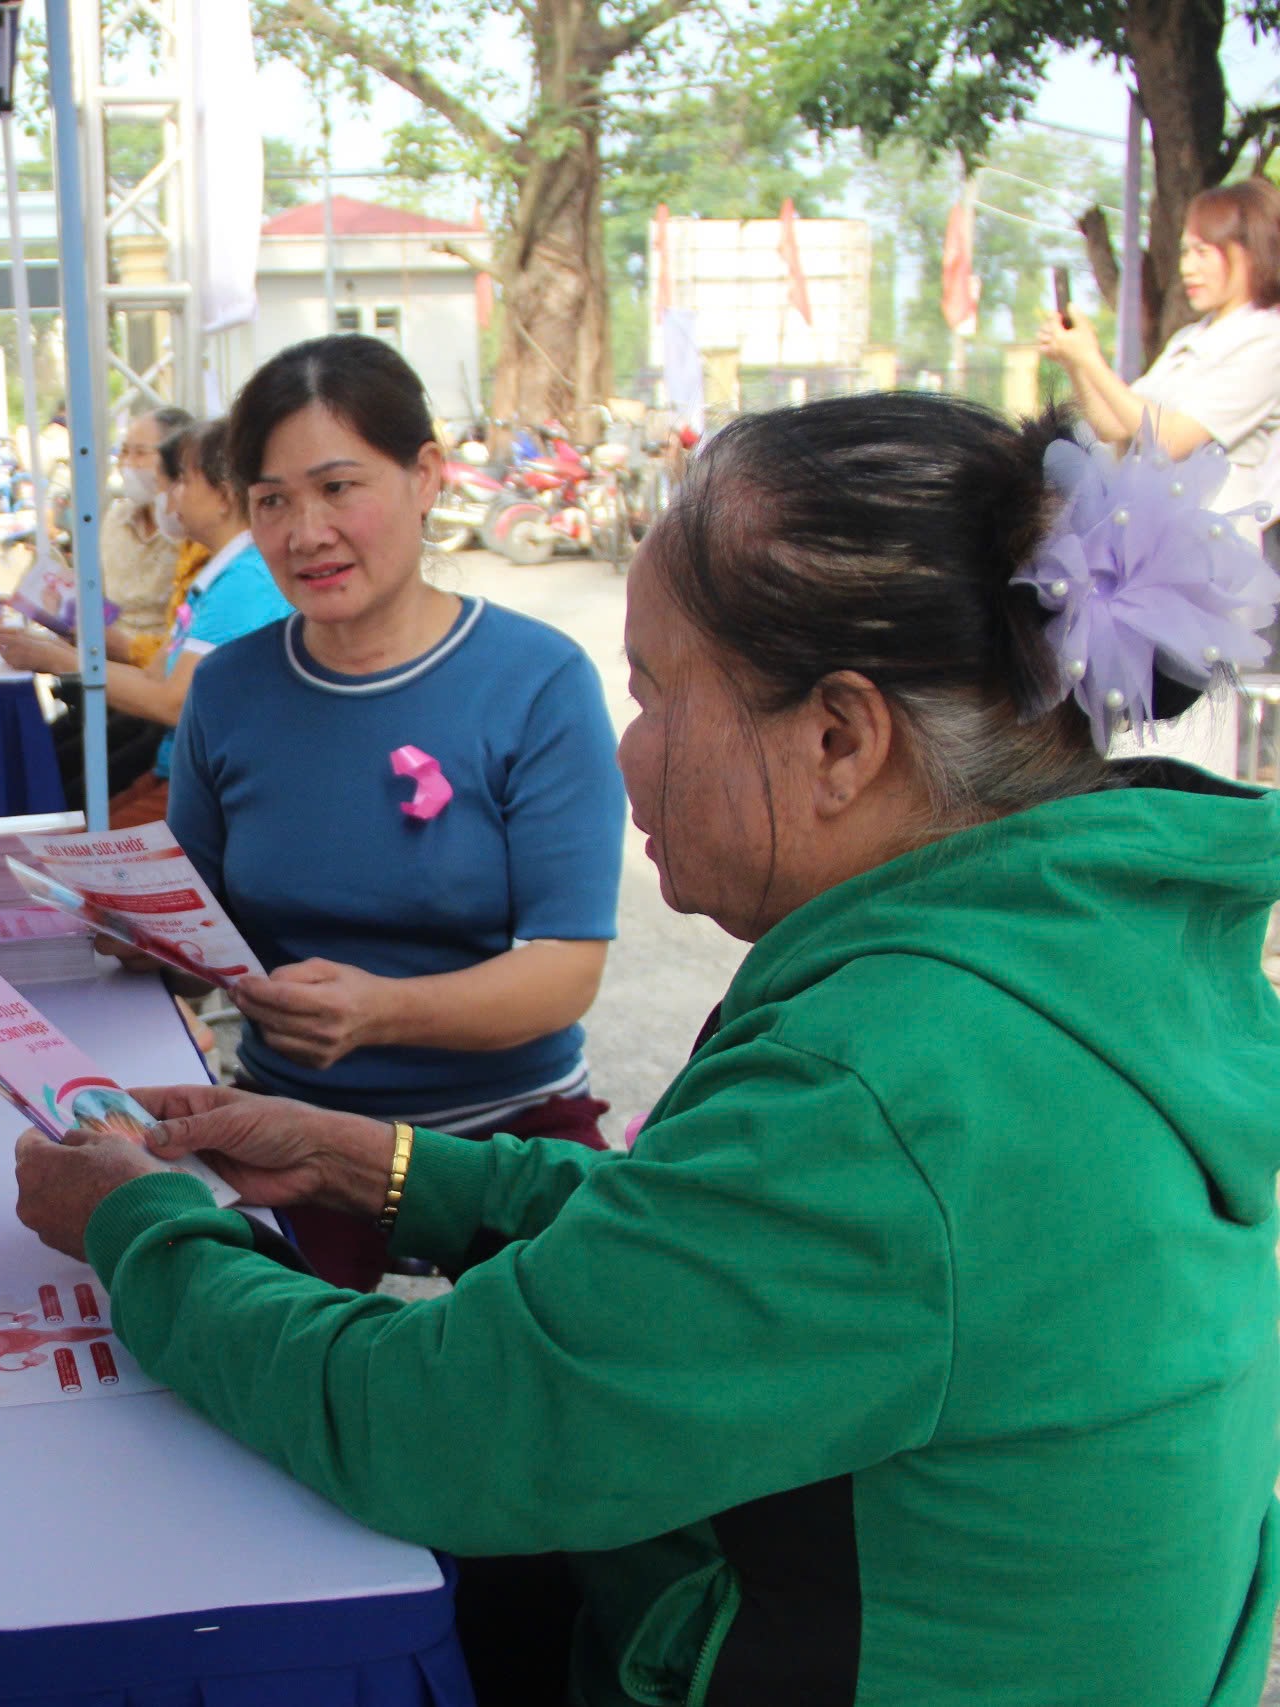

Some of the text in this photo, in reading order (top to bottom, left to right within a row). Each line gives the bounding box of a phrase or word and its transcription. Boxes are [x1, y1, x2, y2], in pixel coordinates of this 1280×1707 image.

[61, 843, 94, 857] KHÁM
[92, 840, 117, 856] SỨC
[0, 1026, 25, 1041] UNG
